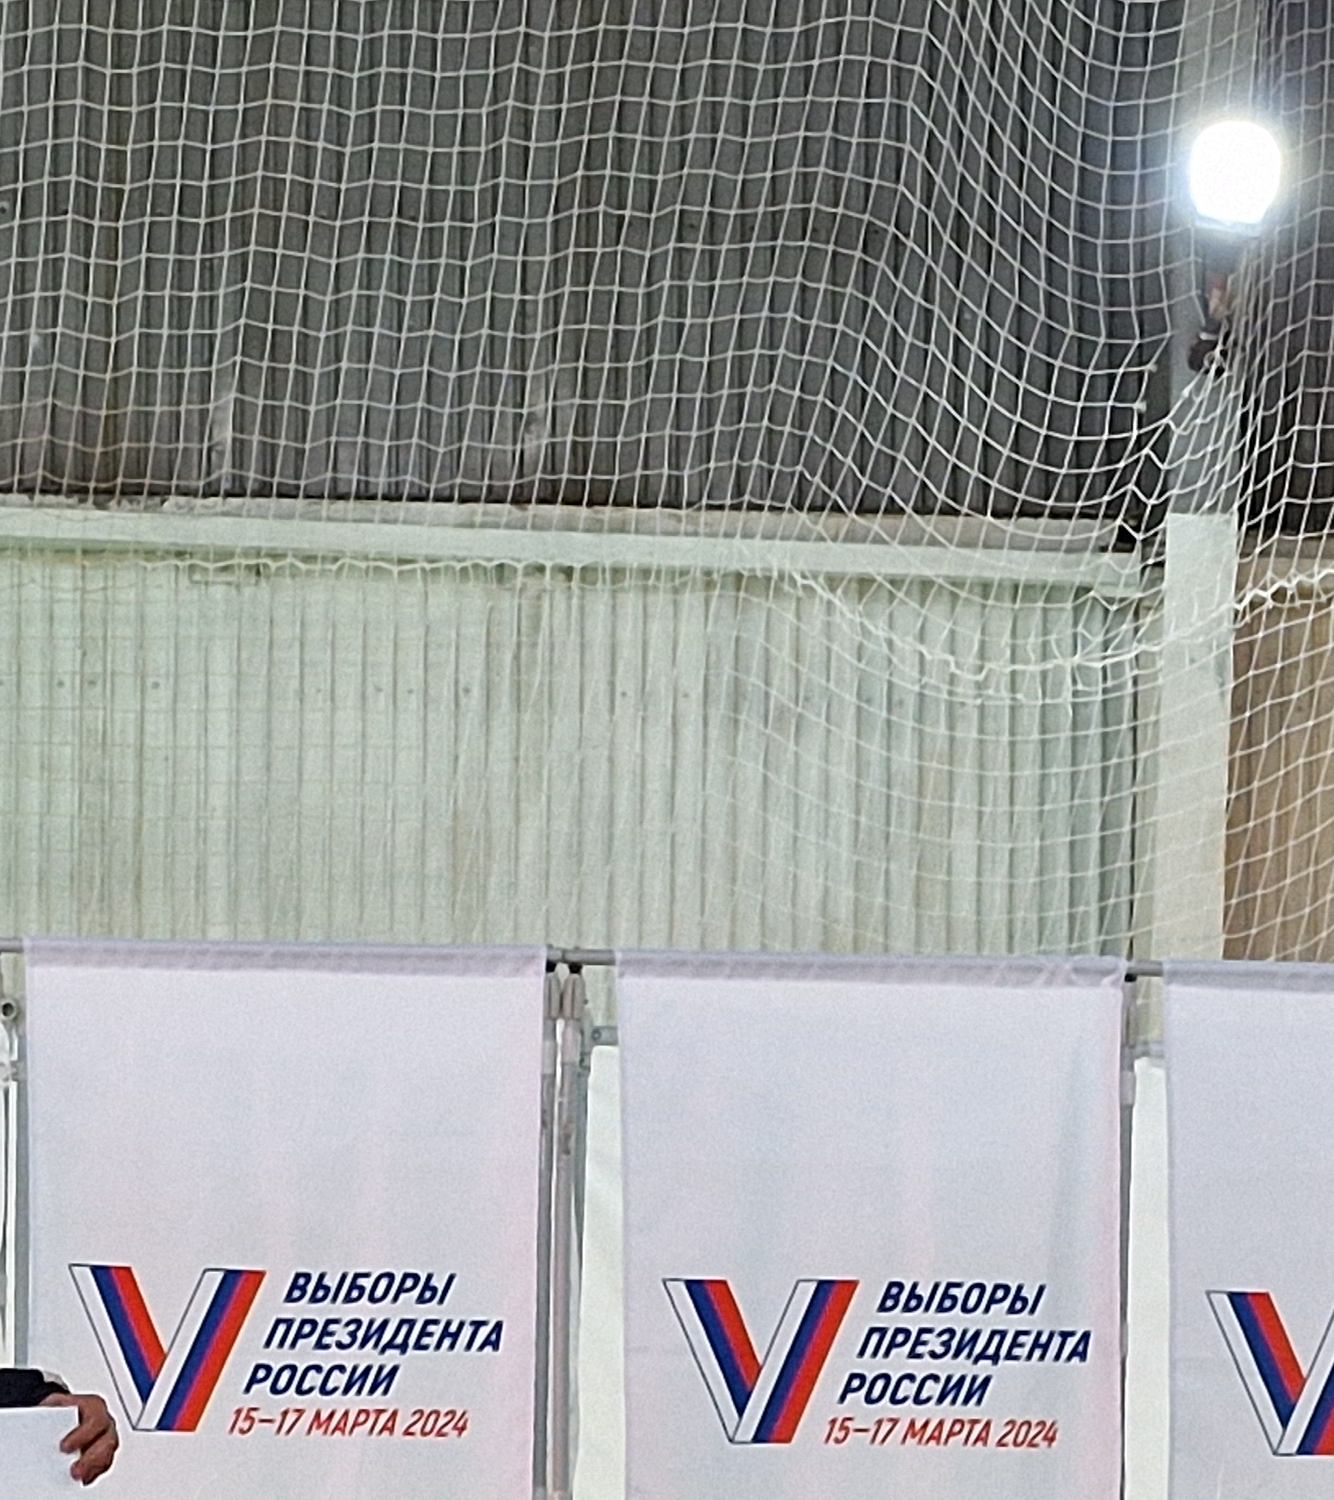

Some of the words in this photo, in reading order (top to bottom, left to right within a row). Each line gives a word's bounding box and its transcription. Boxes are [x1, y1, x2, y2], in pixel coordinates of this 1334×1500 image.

[283, 1272, 456, 1304] ВЫБОРЫ
[876, 1280, 1046, 1316] ВЫБОРЫ
[264, 1318, 503, 1354] ПРЕЗИДЕНТА
[856, 1326, 1091, 1366] ПРЕЗИДЕНТА
[243, 1364, 400, 1396] РОССИИ
[837, 1373, 992, 1406] РОССИИ
[307, 1409, 399, 1436] МАРТА
[402, 1409, 468, 1438] 2024
[901, 1419, 992, 1447] МАРТА
[996, 1420, 1057, 1448] 2024
